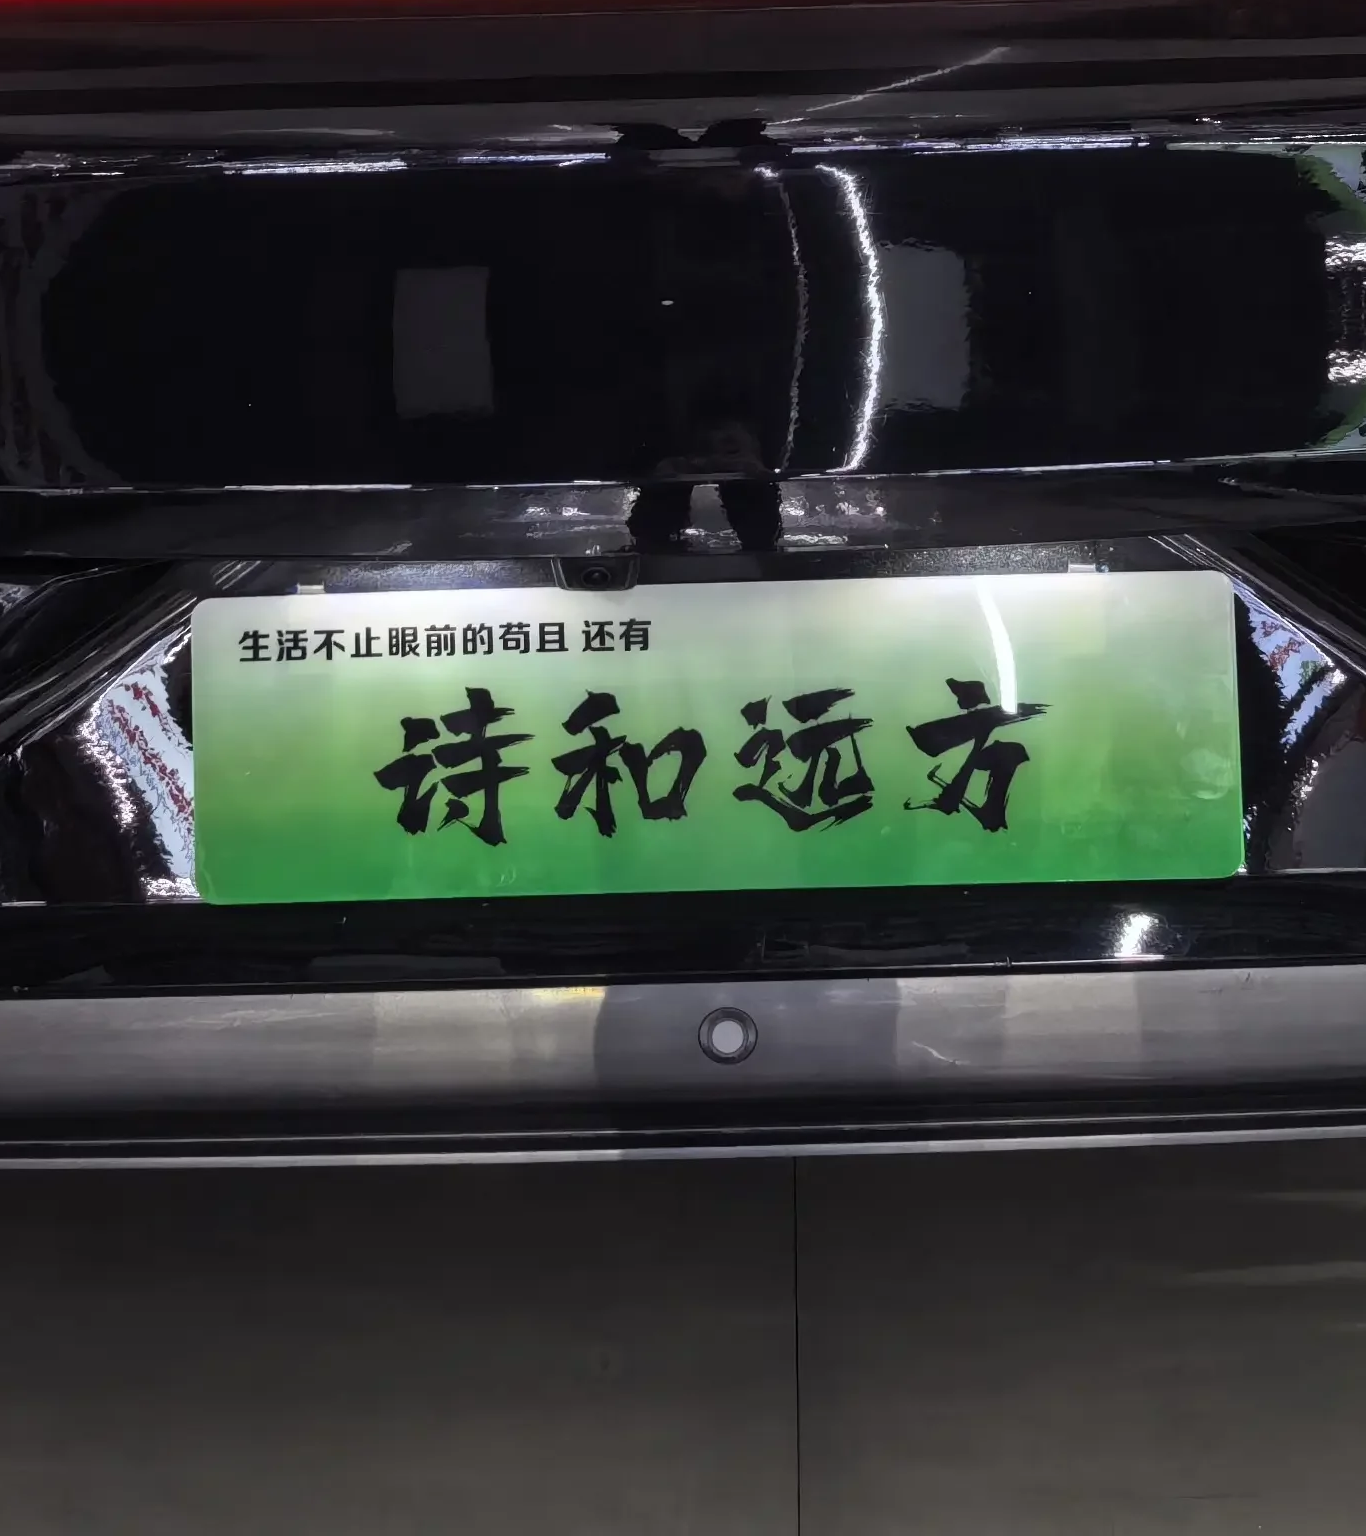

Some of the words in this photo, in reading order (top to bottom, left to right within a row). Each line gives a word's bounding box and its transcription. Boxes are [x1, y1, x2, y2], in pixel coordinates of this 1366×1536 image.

[237, 619, 569, 664] 生活不止眼前的苟且
[581, 617, 652, 655] 还有
[373, 678, 1053, 848] 诗和远方
